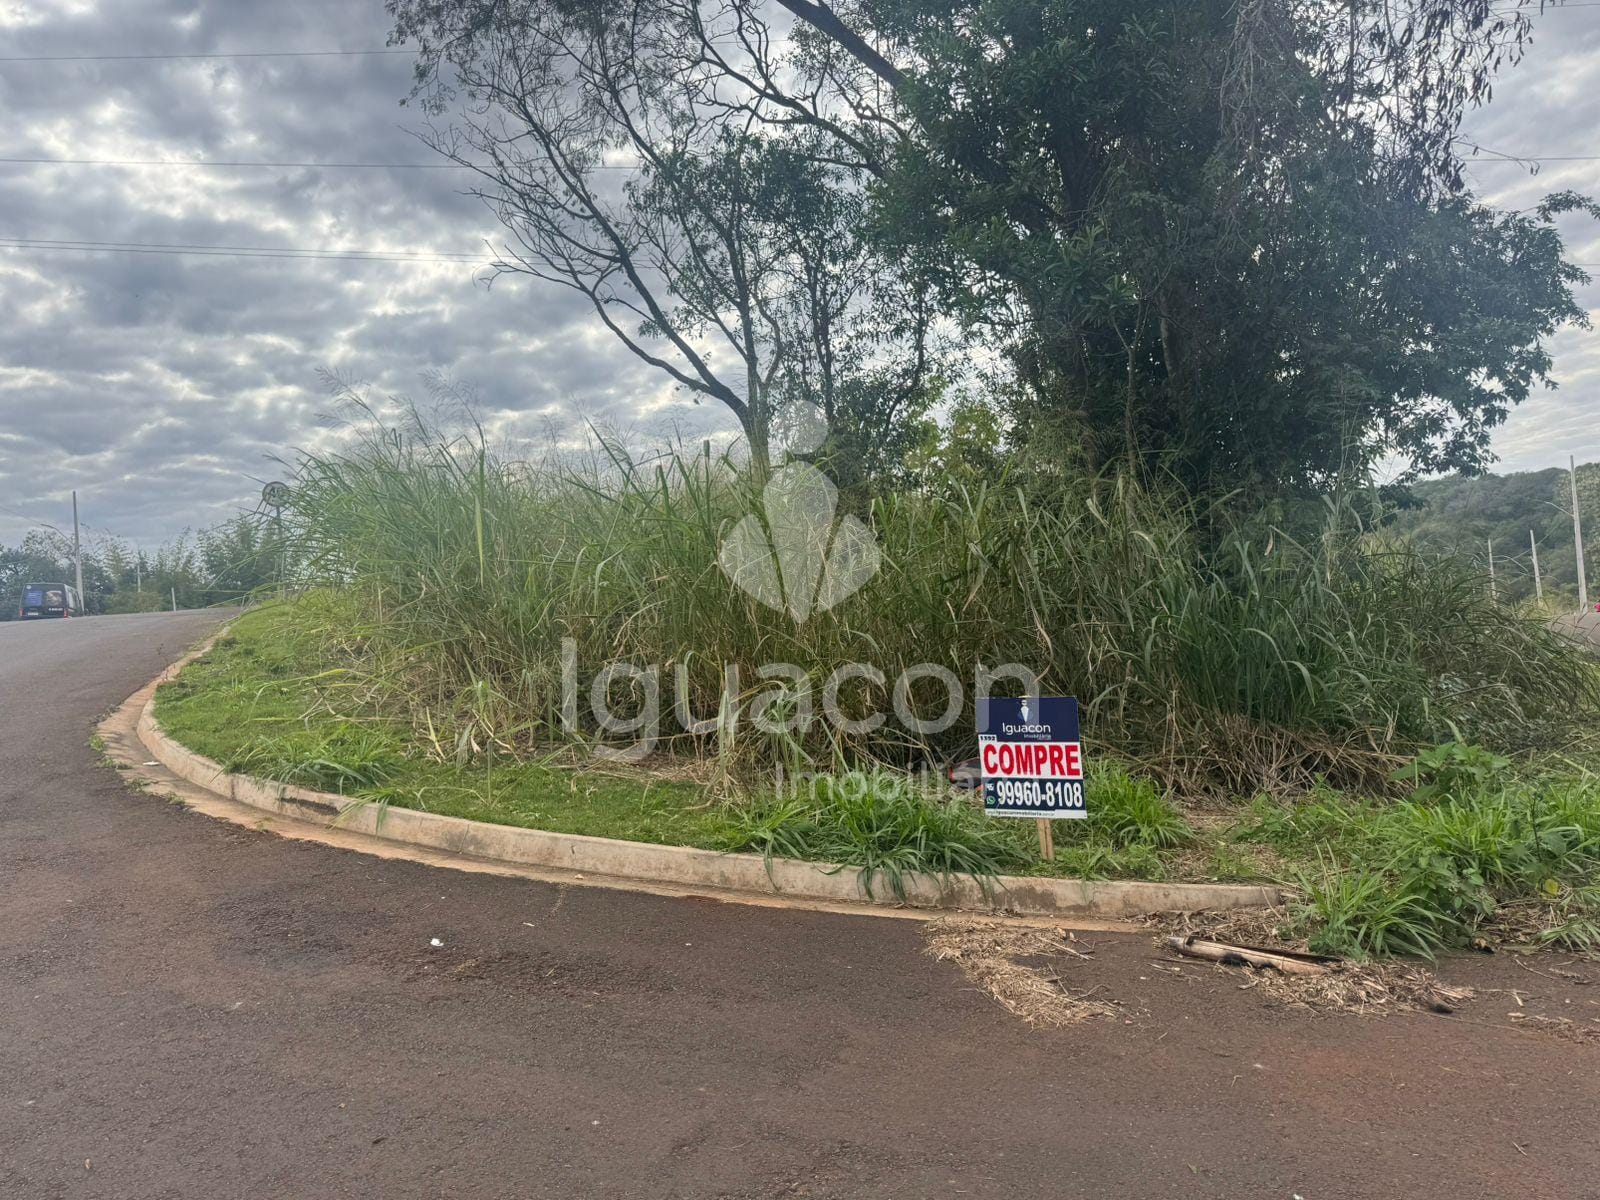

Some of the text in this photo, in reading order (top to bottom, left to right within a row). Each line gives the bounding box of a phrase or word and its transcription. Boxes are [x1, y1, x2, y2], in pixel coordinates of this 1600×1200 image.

[1002, 722, 1051, 735] Iguacon
[983, 743, 1081, 776] COMPRE
[996, 780, 1083, 807] 99960-8108
